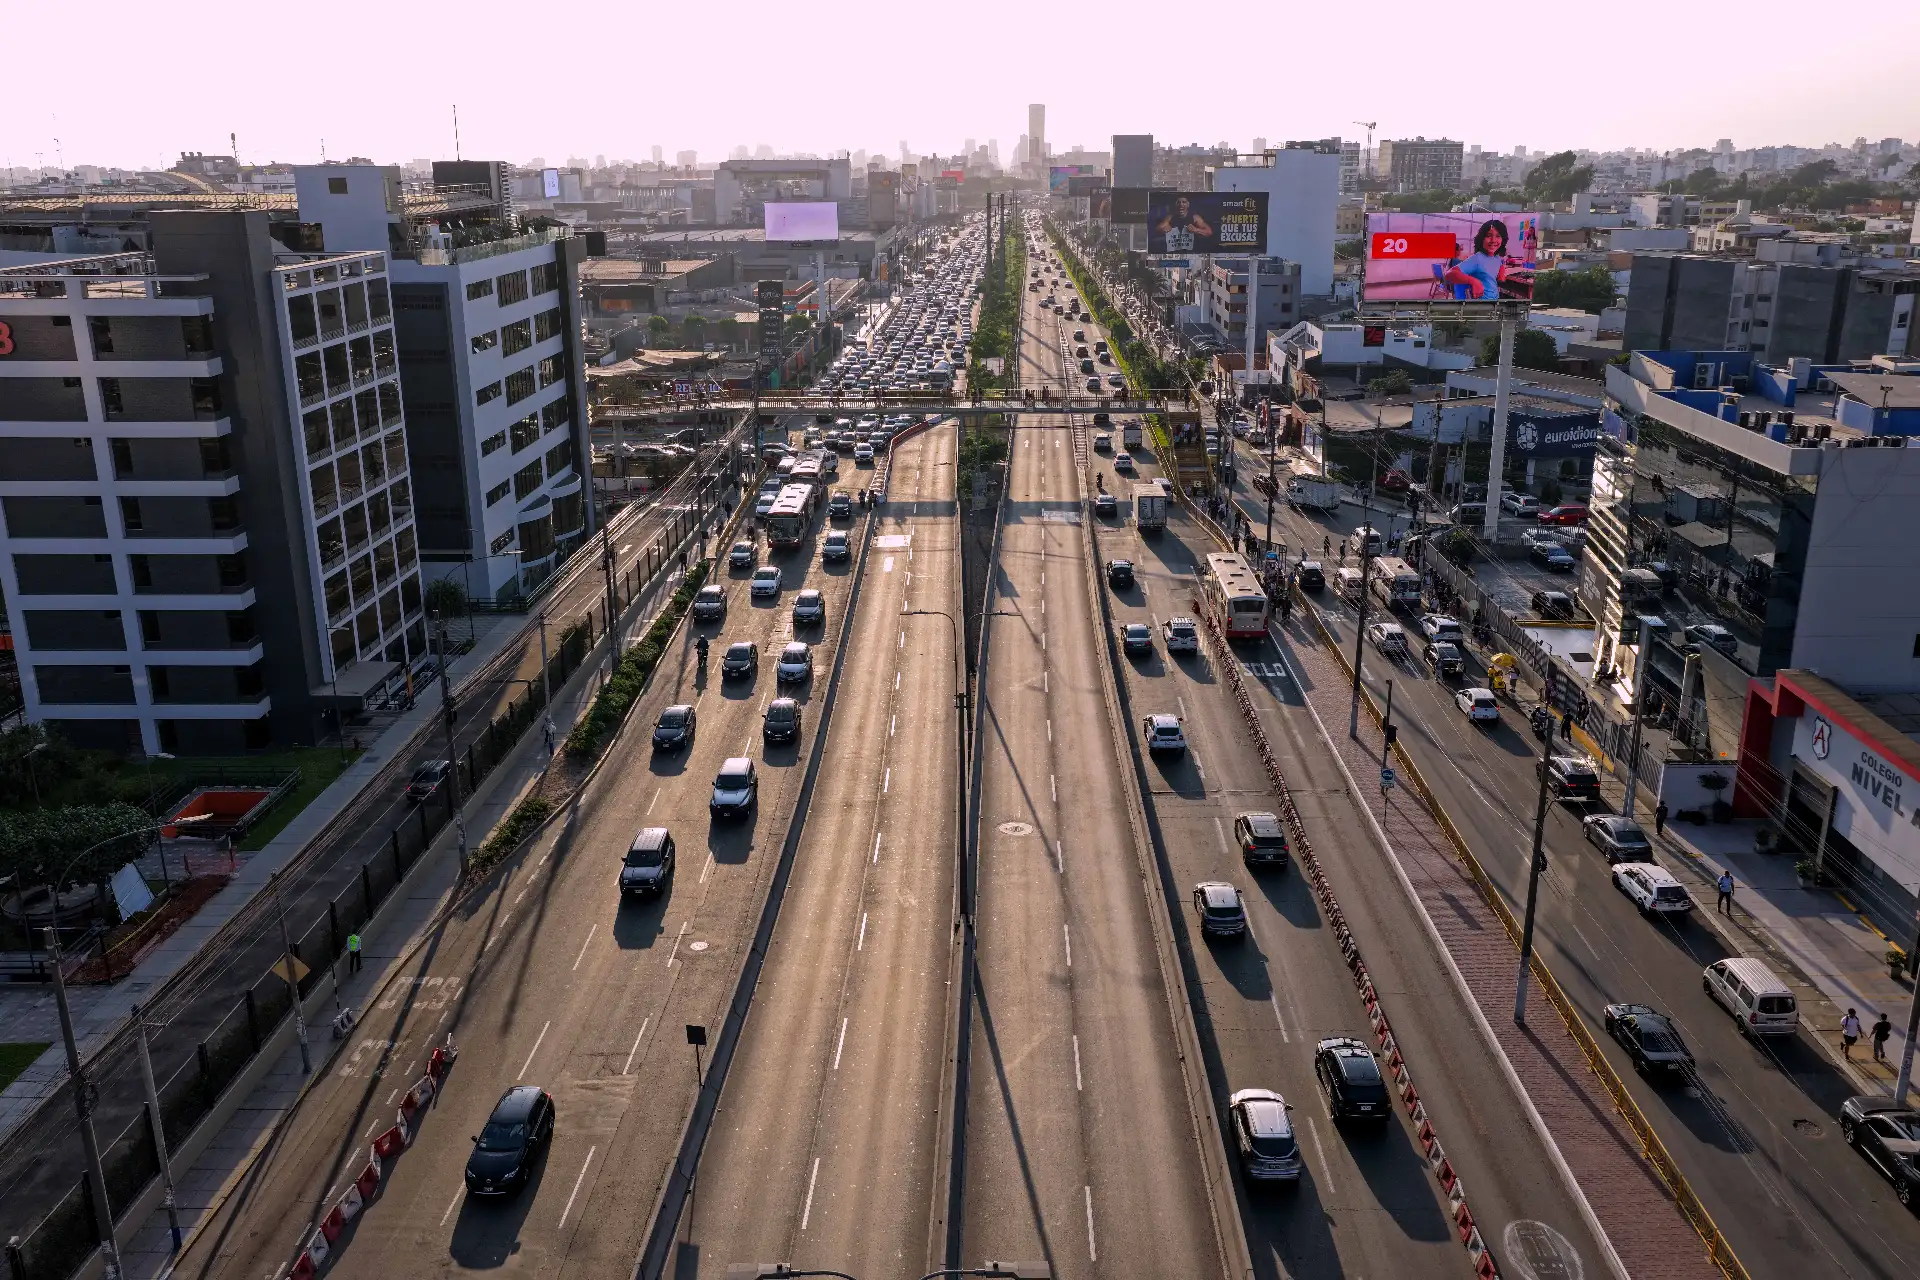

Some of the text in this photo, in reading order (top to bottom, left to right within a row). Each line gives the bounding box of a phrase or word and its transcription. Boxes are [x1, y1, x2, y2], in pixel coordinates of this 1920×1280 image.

[1244, 198, 1257, 208] fit
[1221, 215, 1259, 224] +FUERTE
[1221, 224, 1258, 233] QUE TUS
[1220, 233, 1257, 242] EXCUSAS
[1382, 238, 1408, 254] 20
[1240, 662, 1287, 677] SOLO
[1861, 751, 1902, 788] COLEGIO
[1851, 762, 1905, 818] NIVEL
